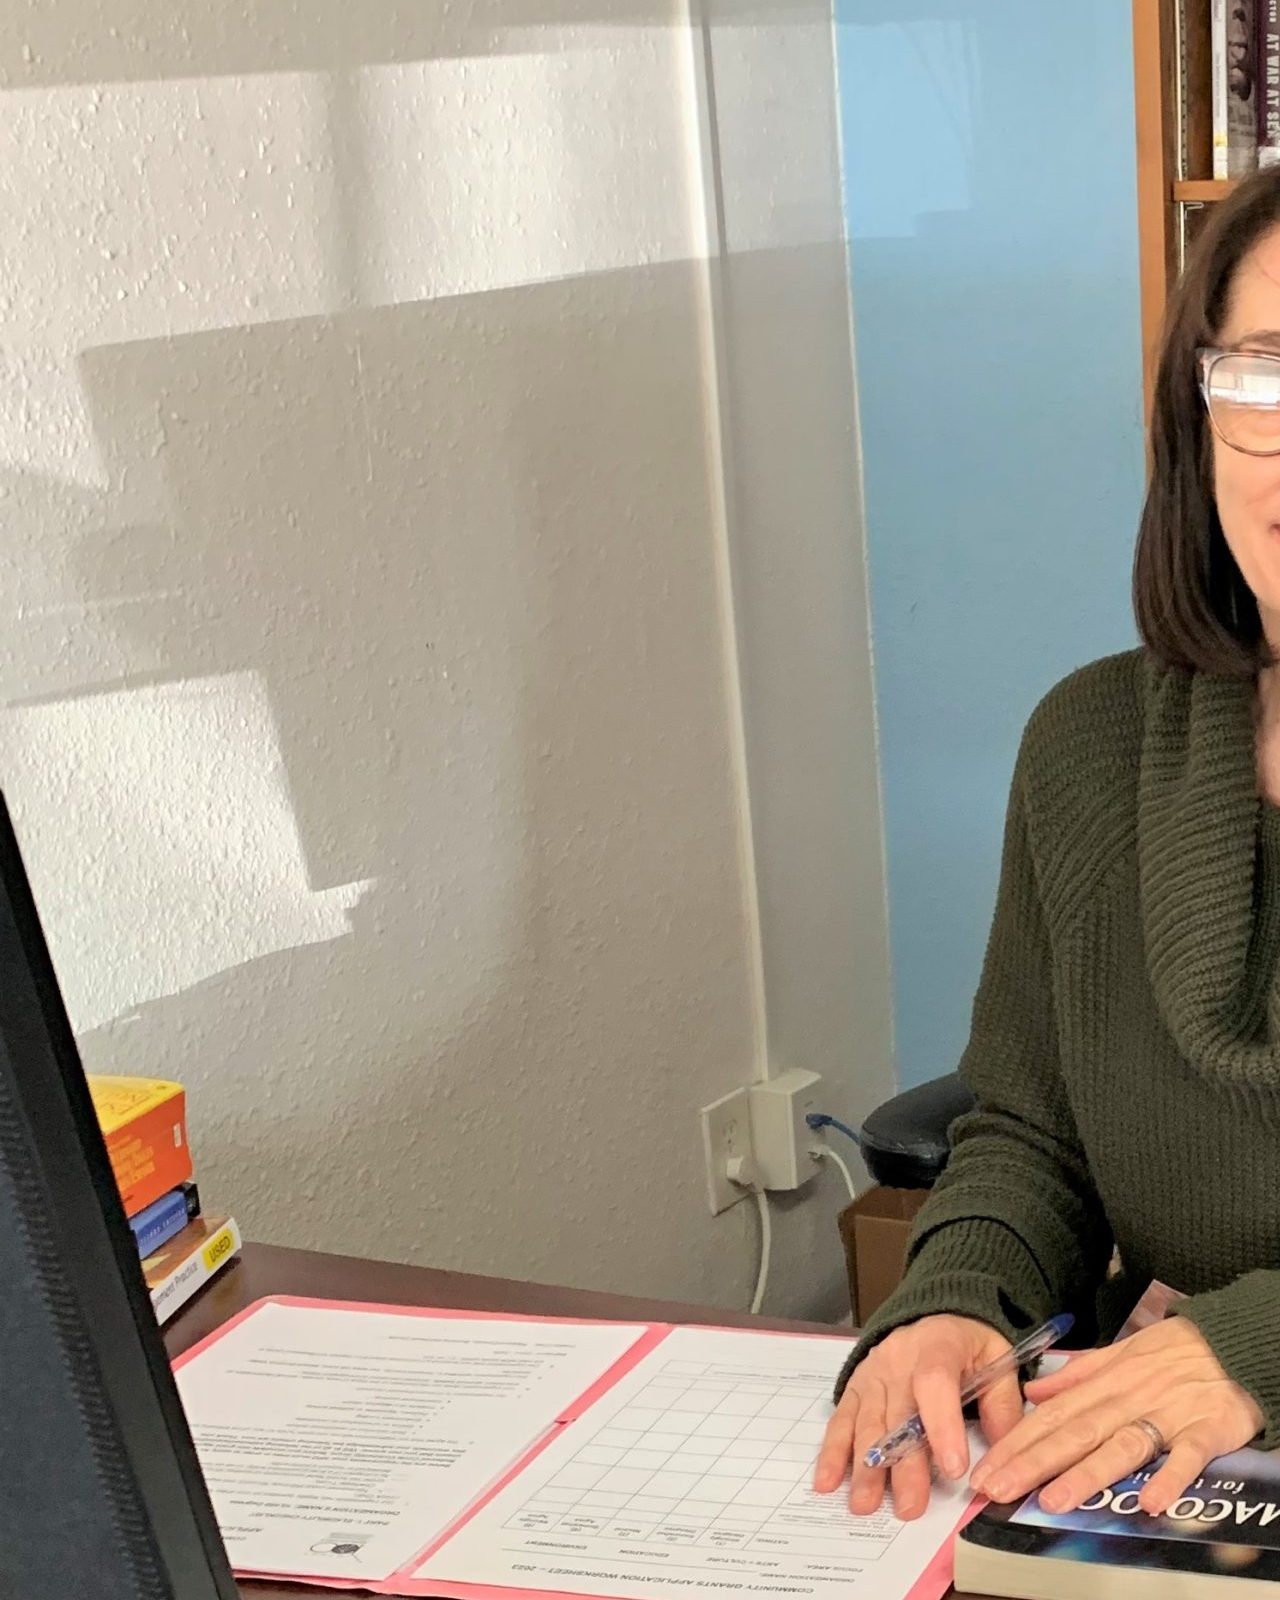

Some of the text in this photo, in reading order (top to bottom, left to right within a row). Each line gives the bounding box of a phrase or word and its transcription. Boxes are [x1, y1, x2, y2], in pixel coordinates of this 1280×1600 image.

[1266, 33, 1280, 107] AT WAR AT
[207, 1236, 231, 1263] USED
[1211, 1479, 1245, 1495] for
[848, 1531, 893, 1539] CRITERIA
[525, 1540, 588, 1550] ENVIRONMENT
[618, 1549, 670, 1558] EDUCATION
[705, 1556, 747, 1564] CULTURE
[548, 1567, 814, 1594] COMMUNITY GRANTS APPLICATION WORKSHEET
